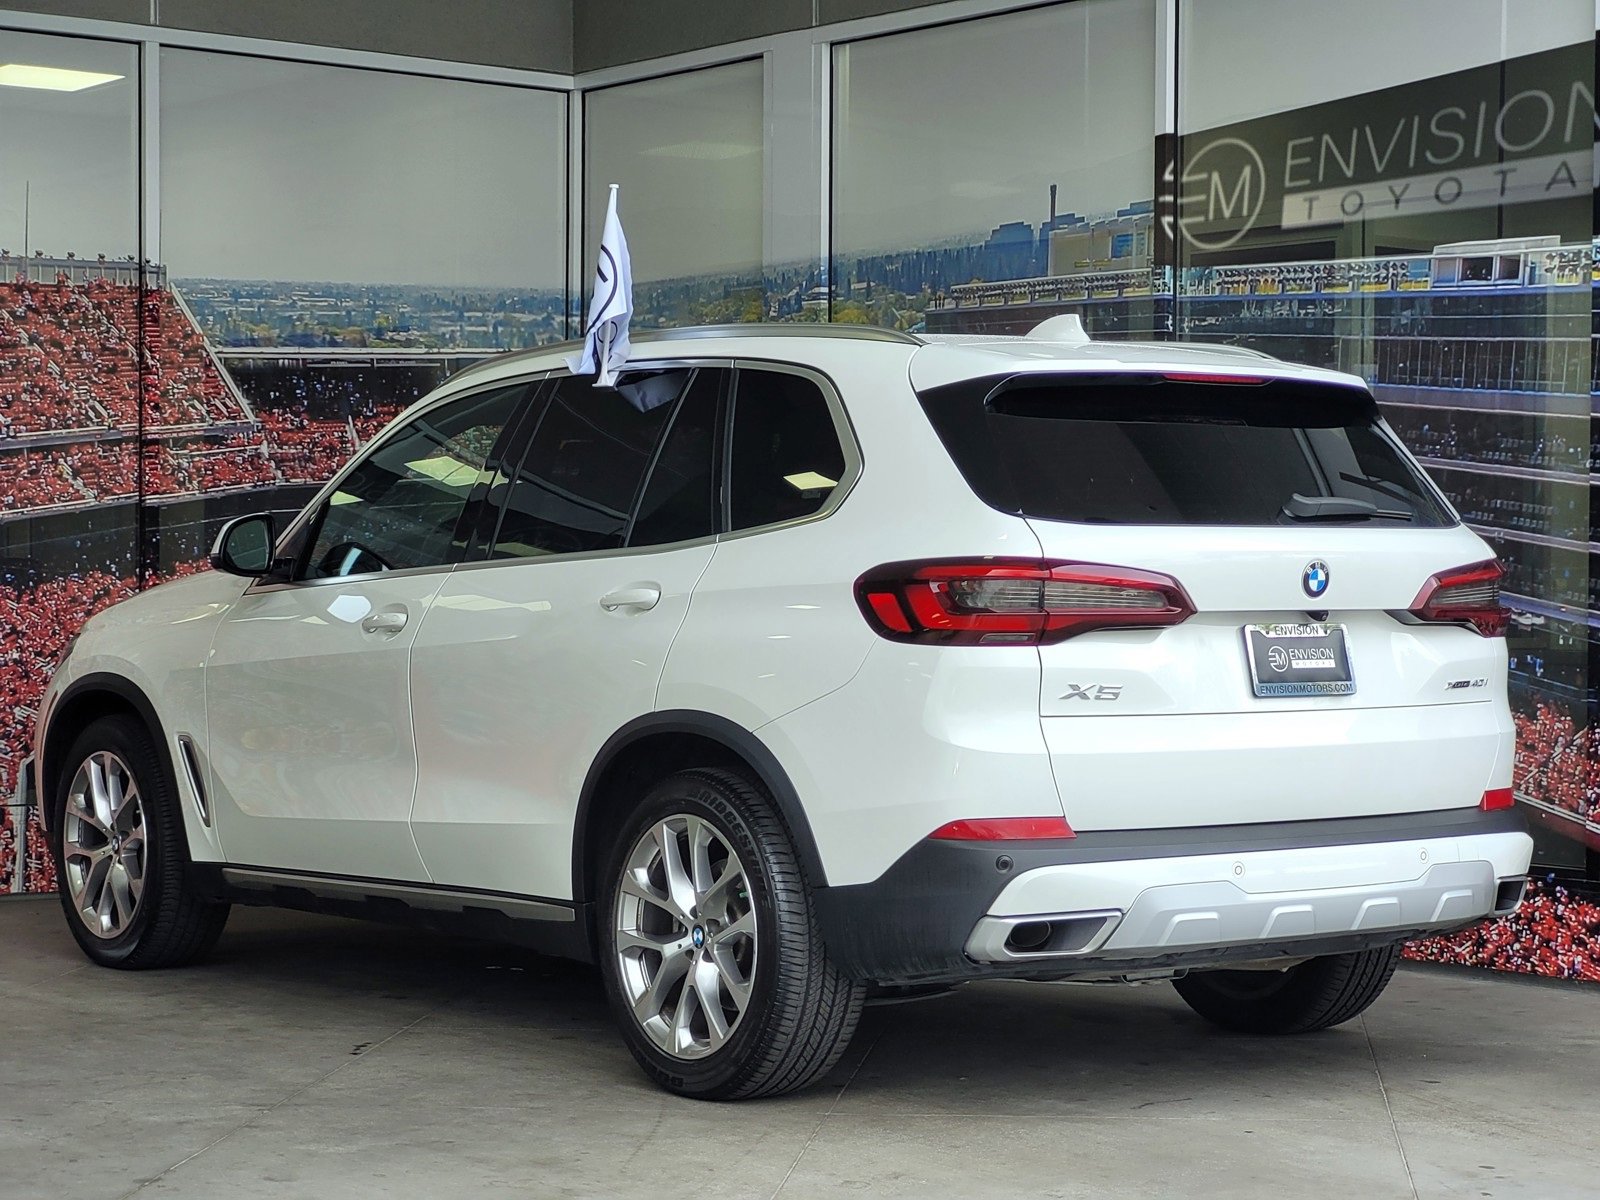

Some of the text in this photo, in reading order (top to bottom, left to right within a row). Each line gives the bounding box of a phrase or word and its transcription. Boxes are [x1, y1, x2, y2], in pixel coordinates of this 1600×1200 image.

[1284, 81, 1600, 188] ENVISION
[1303, 159, 1577, 221] TOYOTA
[1274, 625, 1319, 636] ENVISION
[1288, 648, 1334, 660] ENVISION
[1058, 683, 1123, 701] X5
[1260, 683, 1353, 695] ENVISIONMOTORS.COM
